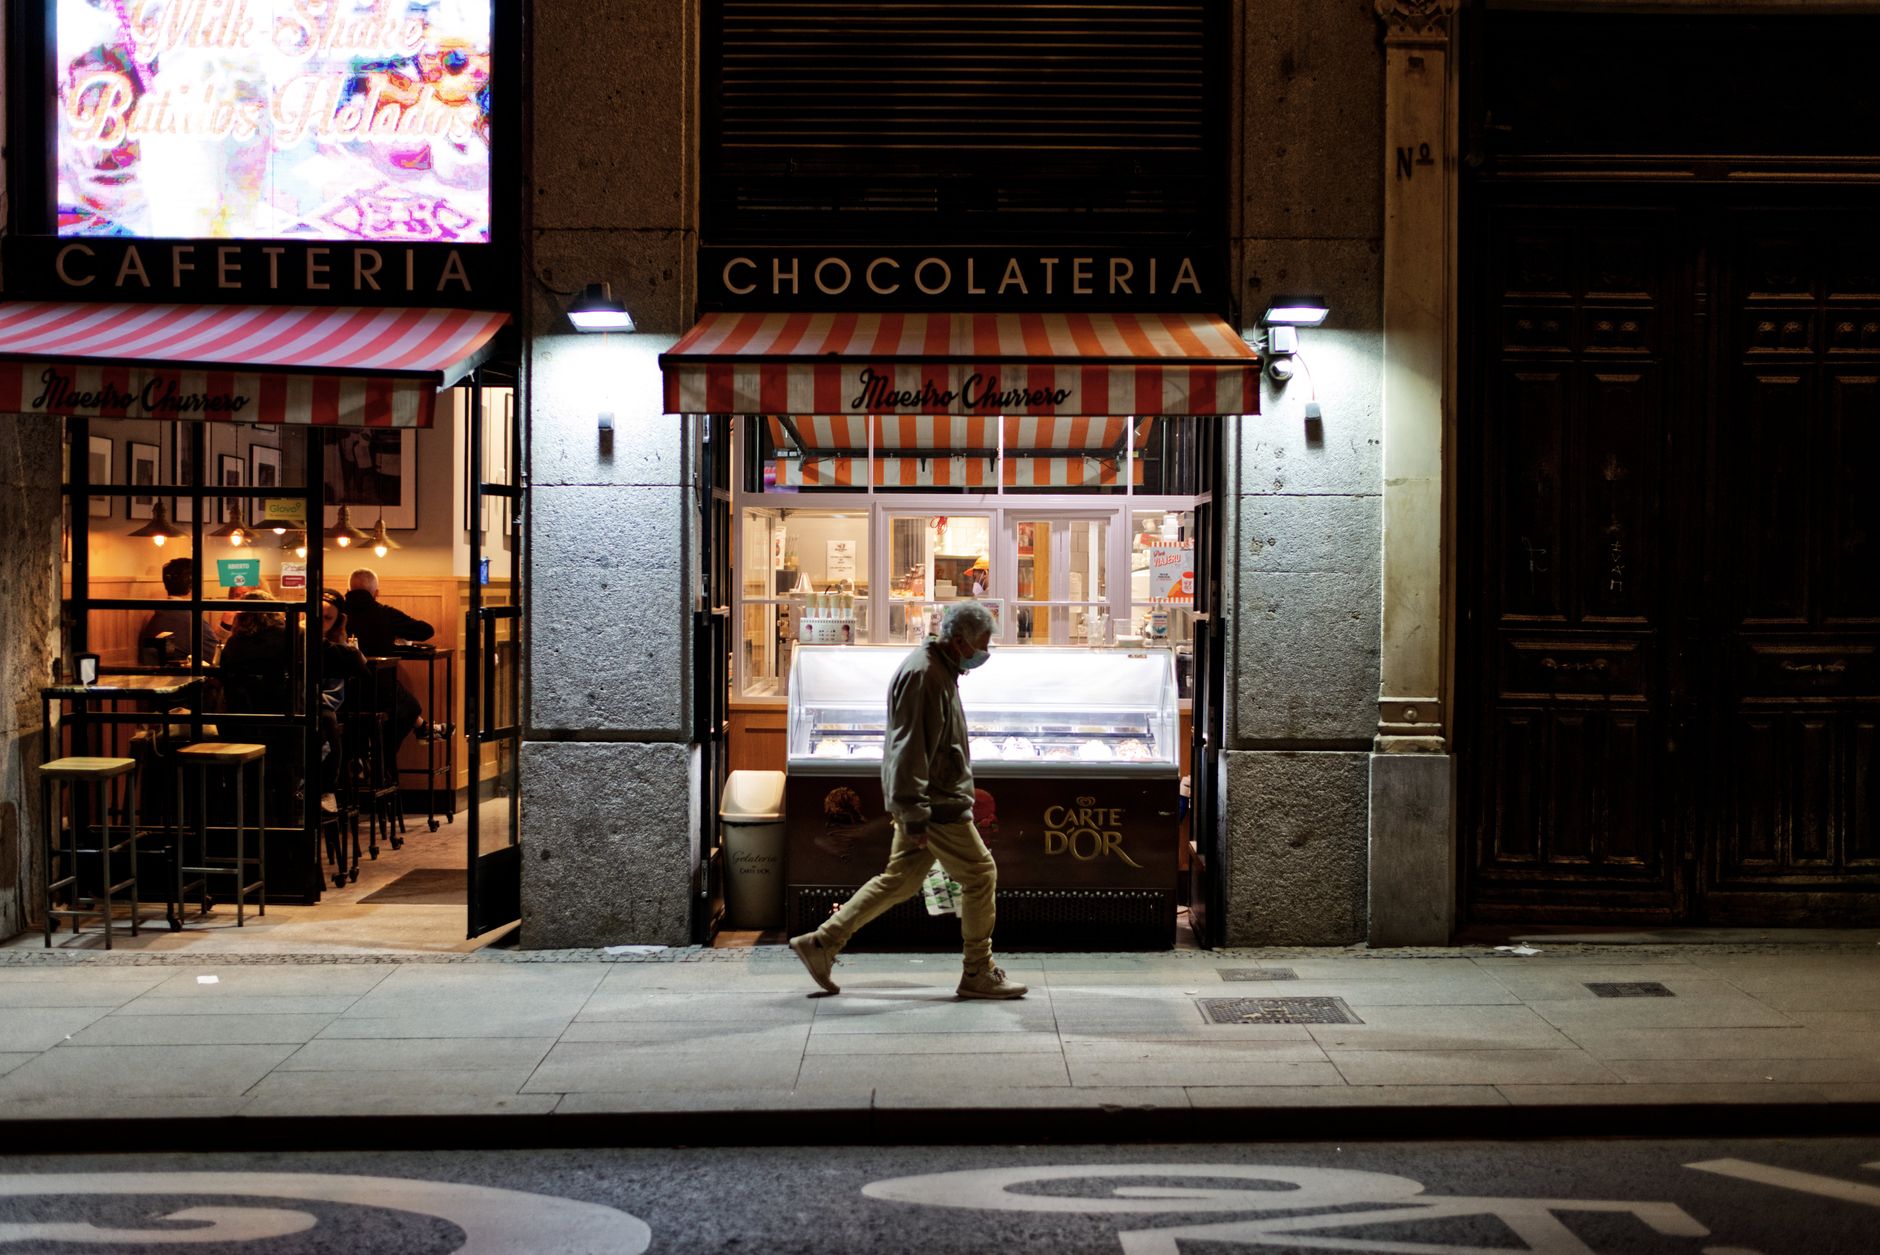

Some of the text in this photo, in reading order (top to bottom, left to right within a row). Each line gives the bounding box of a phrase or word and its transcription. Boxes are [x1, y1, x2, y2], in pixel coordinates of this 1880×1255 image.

[272, 74, 477, 143] Helados
[56, 243, 473, 292] CAFETERIA
[722, 257, 1202, 295] CHOCOLATERIA
[32, 368, 250, 412] Maestro Churrero
[852, 368, 1072, 409] Maestro Churrero
[270, 503, 300, 512] Glovo
[1044, 805, 1121, 830] CARTE
[1044, 826, 1144, 868] D'OR
